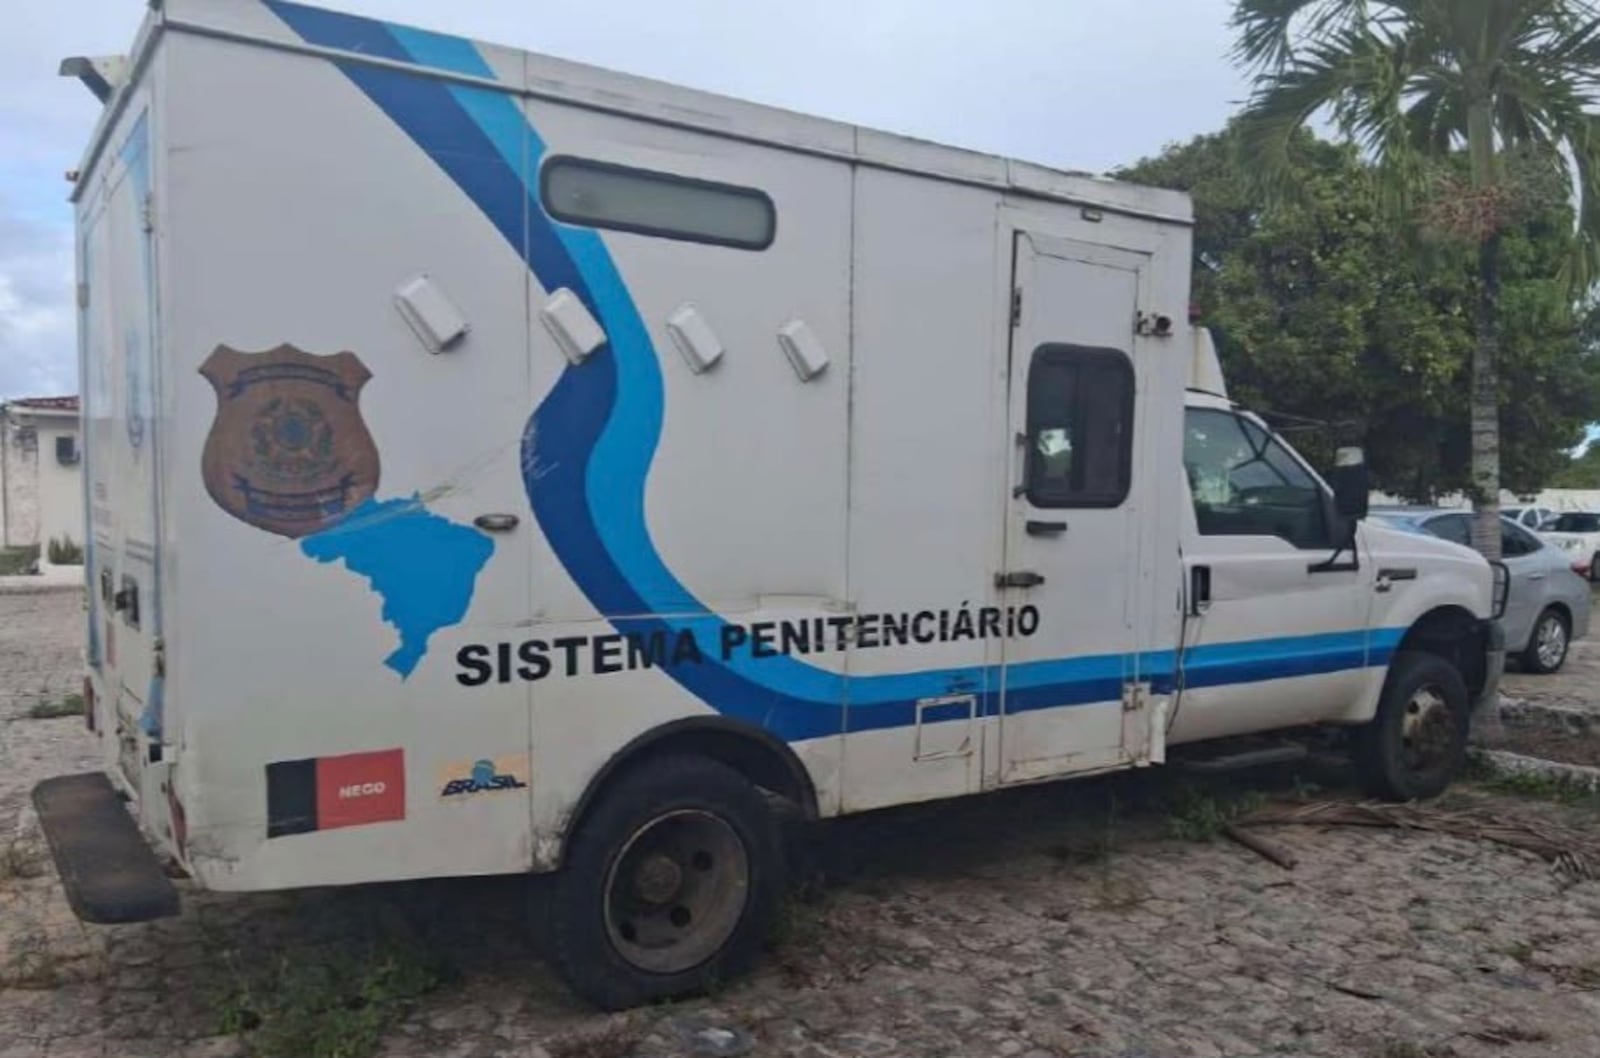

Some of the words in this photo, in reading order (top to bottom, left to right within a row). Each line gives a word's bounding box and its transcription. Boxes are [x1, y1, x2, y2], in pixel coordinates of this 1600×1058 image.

[455, 628, 700, 687] SISTEMA
[338, 781, 386, 799] NEGO
[441, 774, 527, 796] BRASIL
